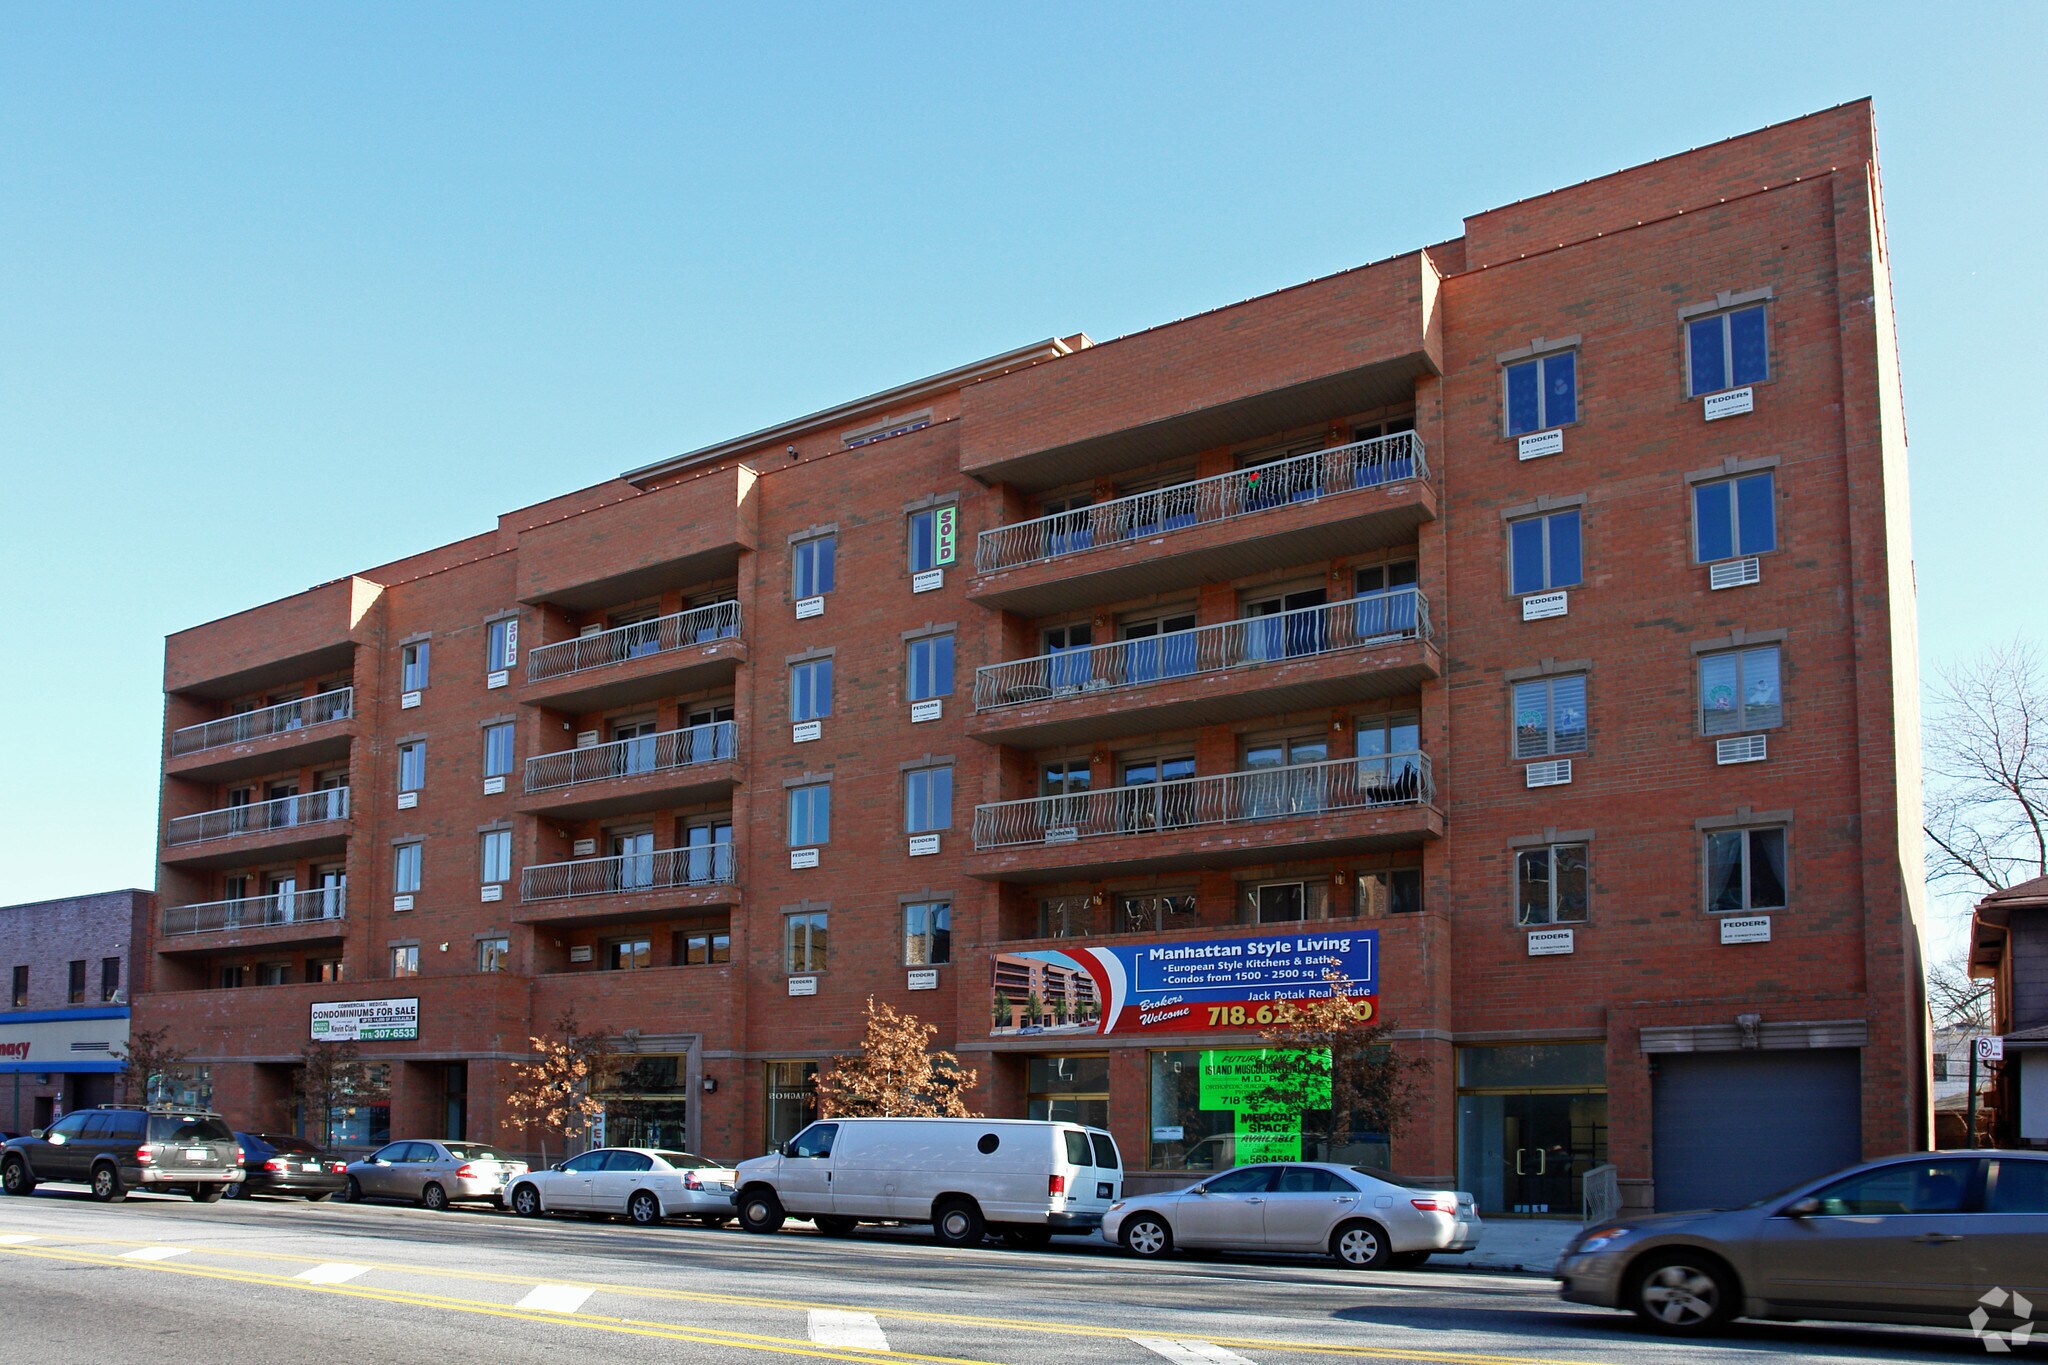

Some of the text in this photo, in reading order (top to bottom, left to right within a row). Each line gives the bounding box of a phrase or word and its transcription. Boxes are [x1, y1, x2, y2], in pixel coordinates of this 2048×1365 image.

[1707, 391, 1749, 405] FEDDERS
[1521, 433, 1559, 446] FEDDERS
[940, 510, 952, 560] SOLD
[914, 572, 940, 581] FEDDERS
[1525, 595, 1563, 605] FEDDERS
[508, 623, 517, 663] SOLD
[913, 703, 938, 711] FEDDERS
[1723, 920, 1767, 928] FEDDERS
[1149, 938, 1351, 961] Manhattan Style Living
[1167, 955, 1335, 973] European Style Kitchens & Bath
[1167, 973, 1204, 985] Condos
[1207, 971, 1232, 982] from
[1235, 970, 1261, 981] 1500
[1272, 969, 1299, 980] 2500
[1302, 970, 1318, 979] sq.
[1248, 991, 1271, 1001] Jack
[1274, 989, 1305, 1000] Potak
[1308, 988, 1332, 998] Real
[1139, 993, 1184, 1012] Brokers
[312, 1006, 416, 1019] CONDOMINIUMS FOR SALE
[1139, 1006, 1191, 1025] Welcome
[1221, 1053, 1293, 1063] FUTURE HOME
[1205, 1065, 1232, 1075] ISLAND
[1240, 1113, 1296, 1122] MEDICAL
[593, 1108, 603, 1149] PEN
[1248, 1123, 1289, 1133] SPACE
